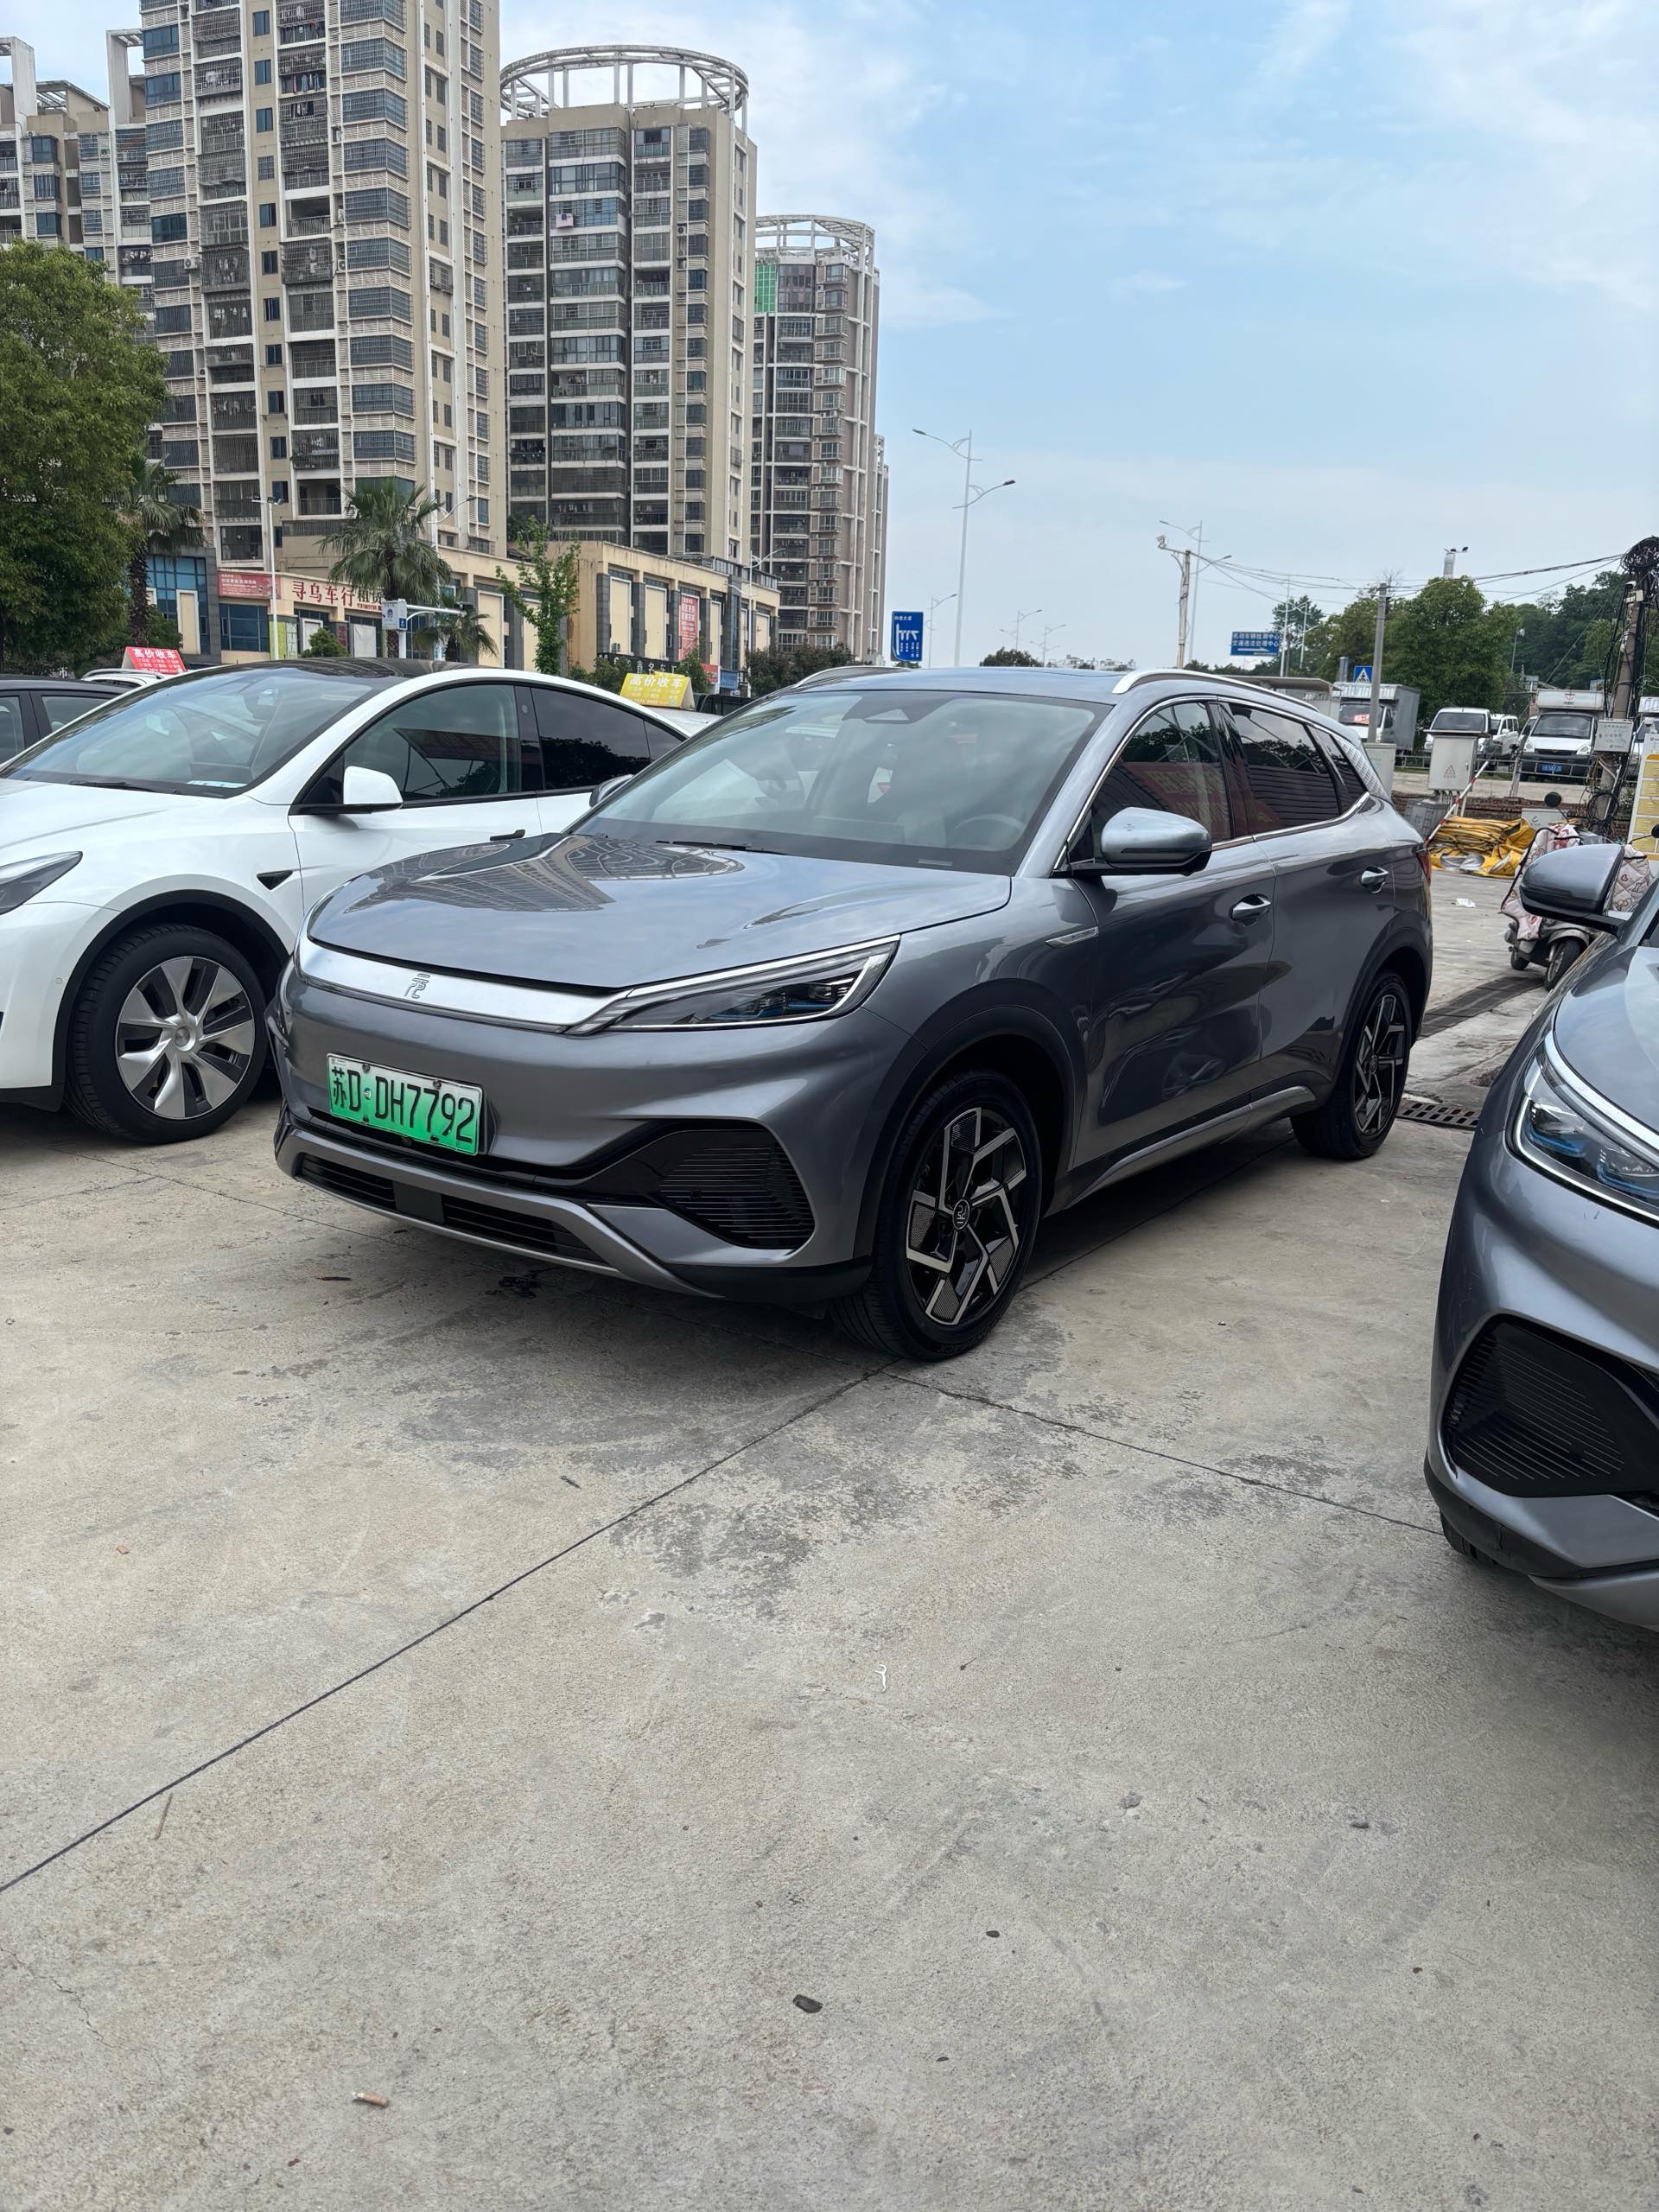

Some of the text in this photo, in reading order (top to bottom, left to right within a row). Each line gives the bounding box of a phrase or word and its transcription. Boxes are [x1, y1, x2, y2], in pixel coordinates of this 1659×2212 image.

[292, 581, 354, 607] 寻乌车行
[132, 648, 177, 660] 高价收车
[629, 676, 683, 688] 高价收车
